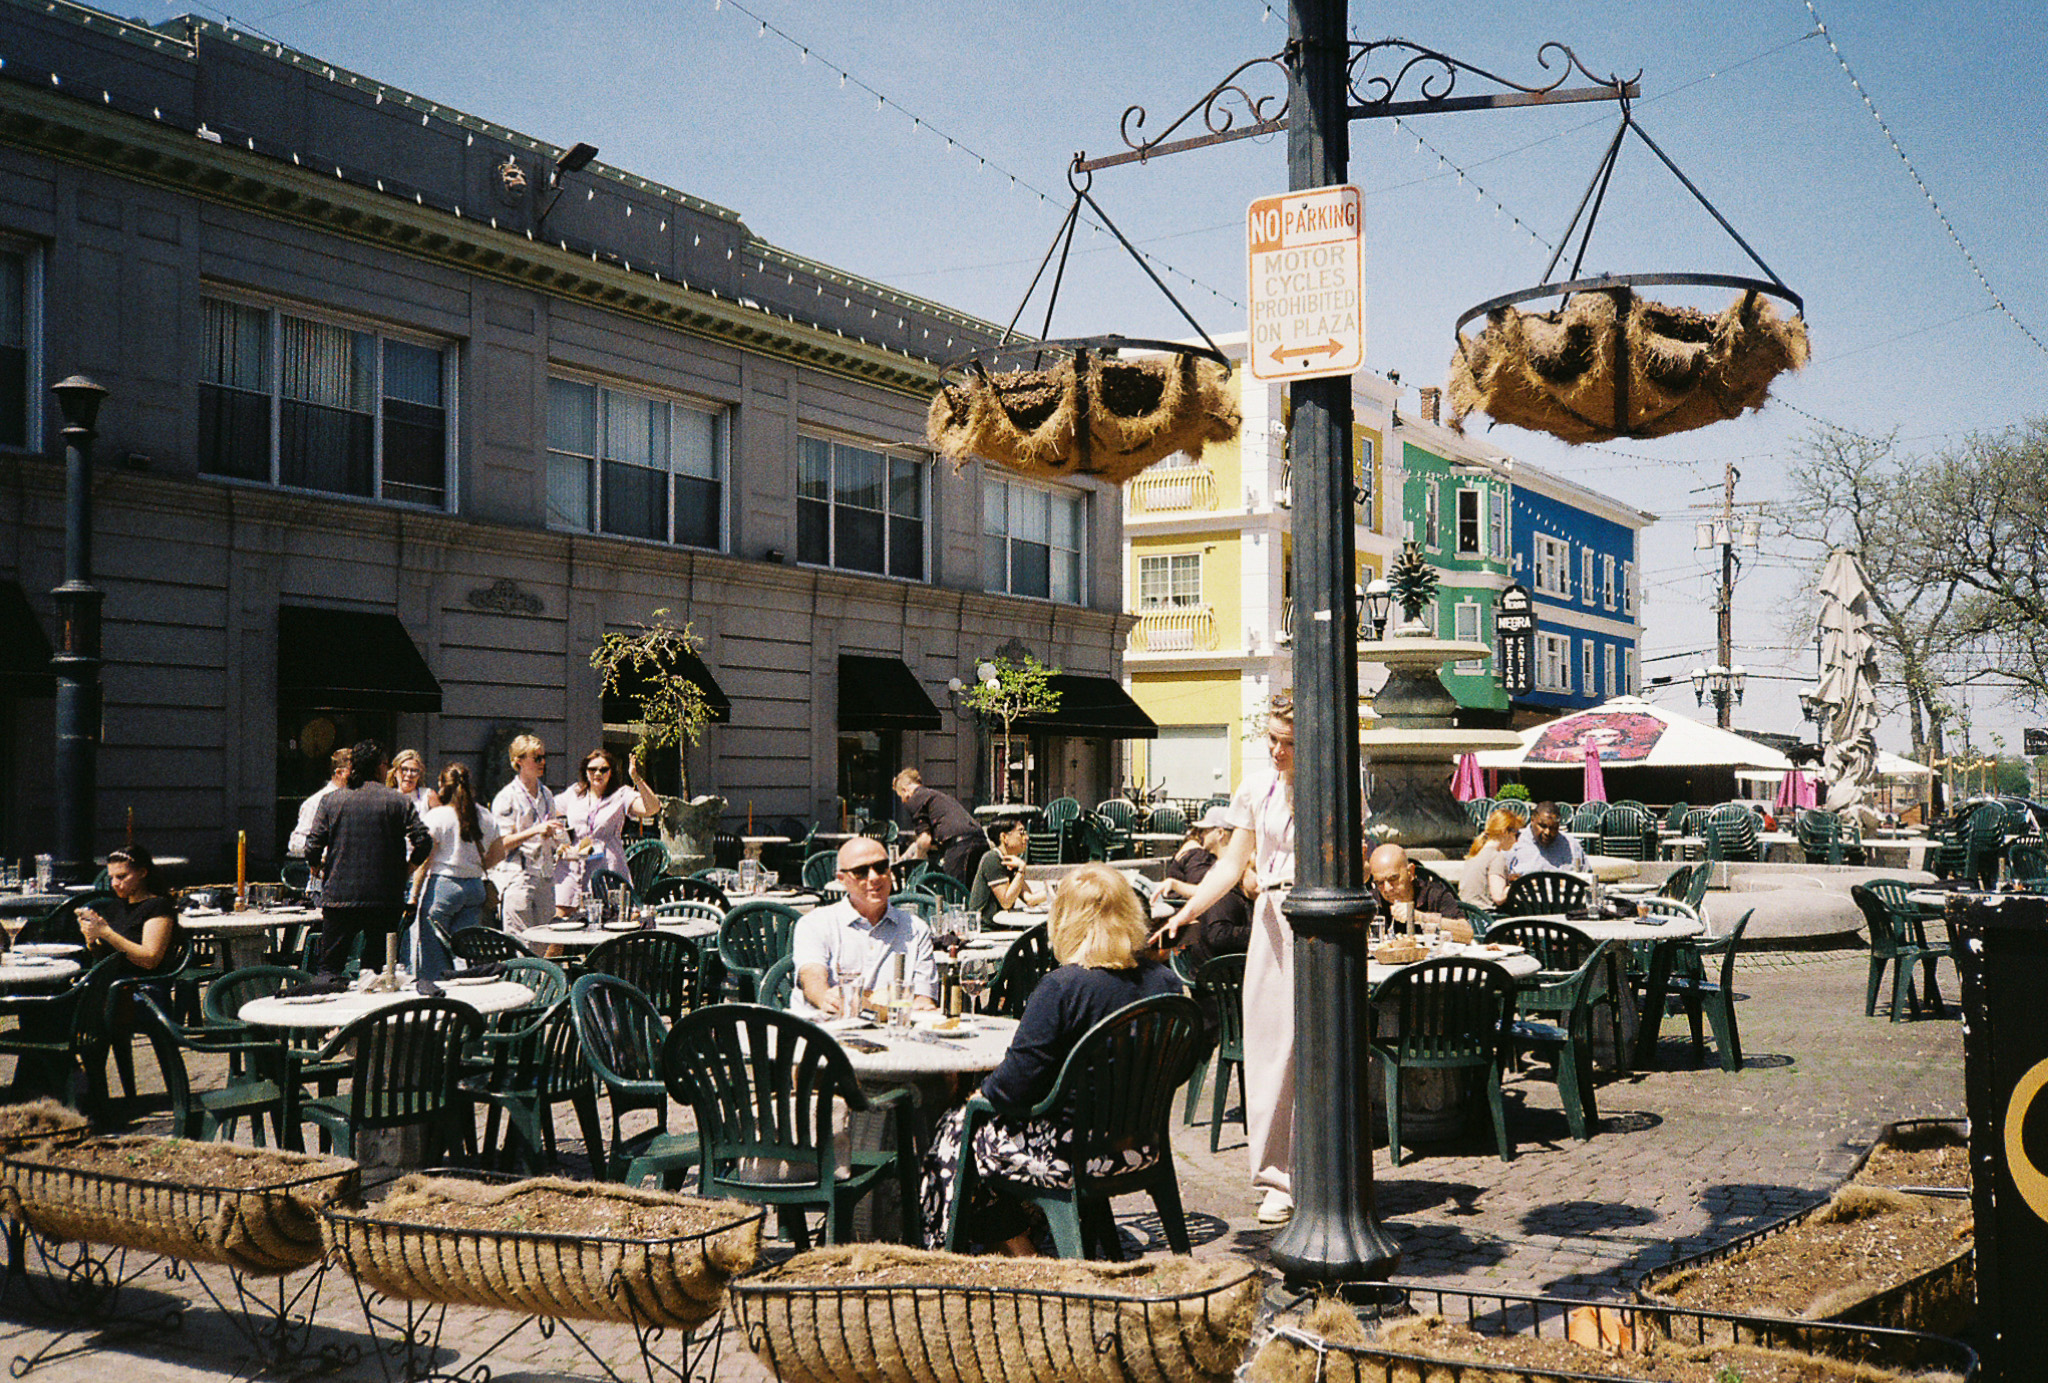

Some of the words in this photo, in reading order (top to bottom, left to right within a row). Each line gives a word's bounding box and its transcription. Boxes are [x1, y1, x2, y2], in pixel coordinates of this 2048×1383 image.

[1251, 209, 1281, 245] NO
[1286, 203, 1355, 235] PARKING
[1265, 246, 1345, 274] MOTOR
[1265, 268, 1345, 297] CYCLES
[1255, 289, 1355, 320] PROHIBITED
[1256, 323, 1281, 343] ON
[1293, 313, 1356, 339] PLAZA
[1498, 616, 1531, 630] NEGRA
[1505, 637, 1515, 689] MEXICAN
[1517, 637, 1526, 689] CANTINA
